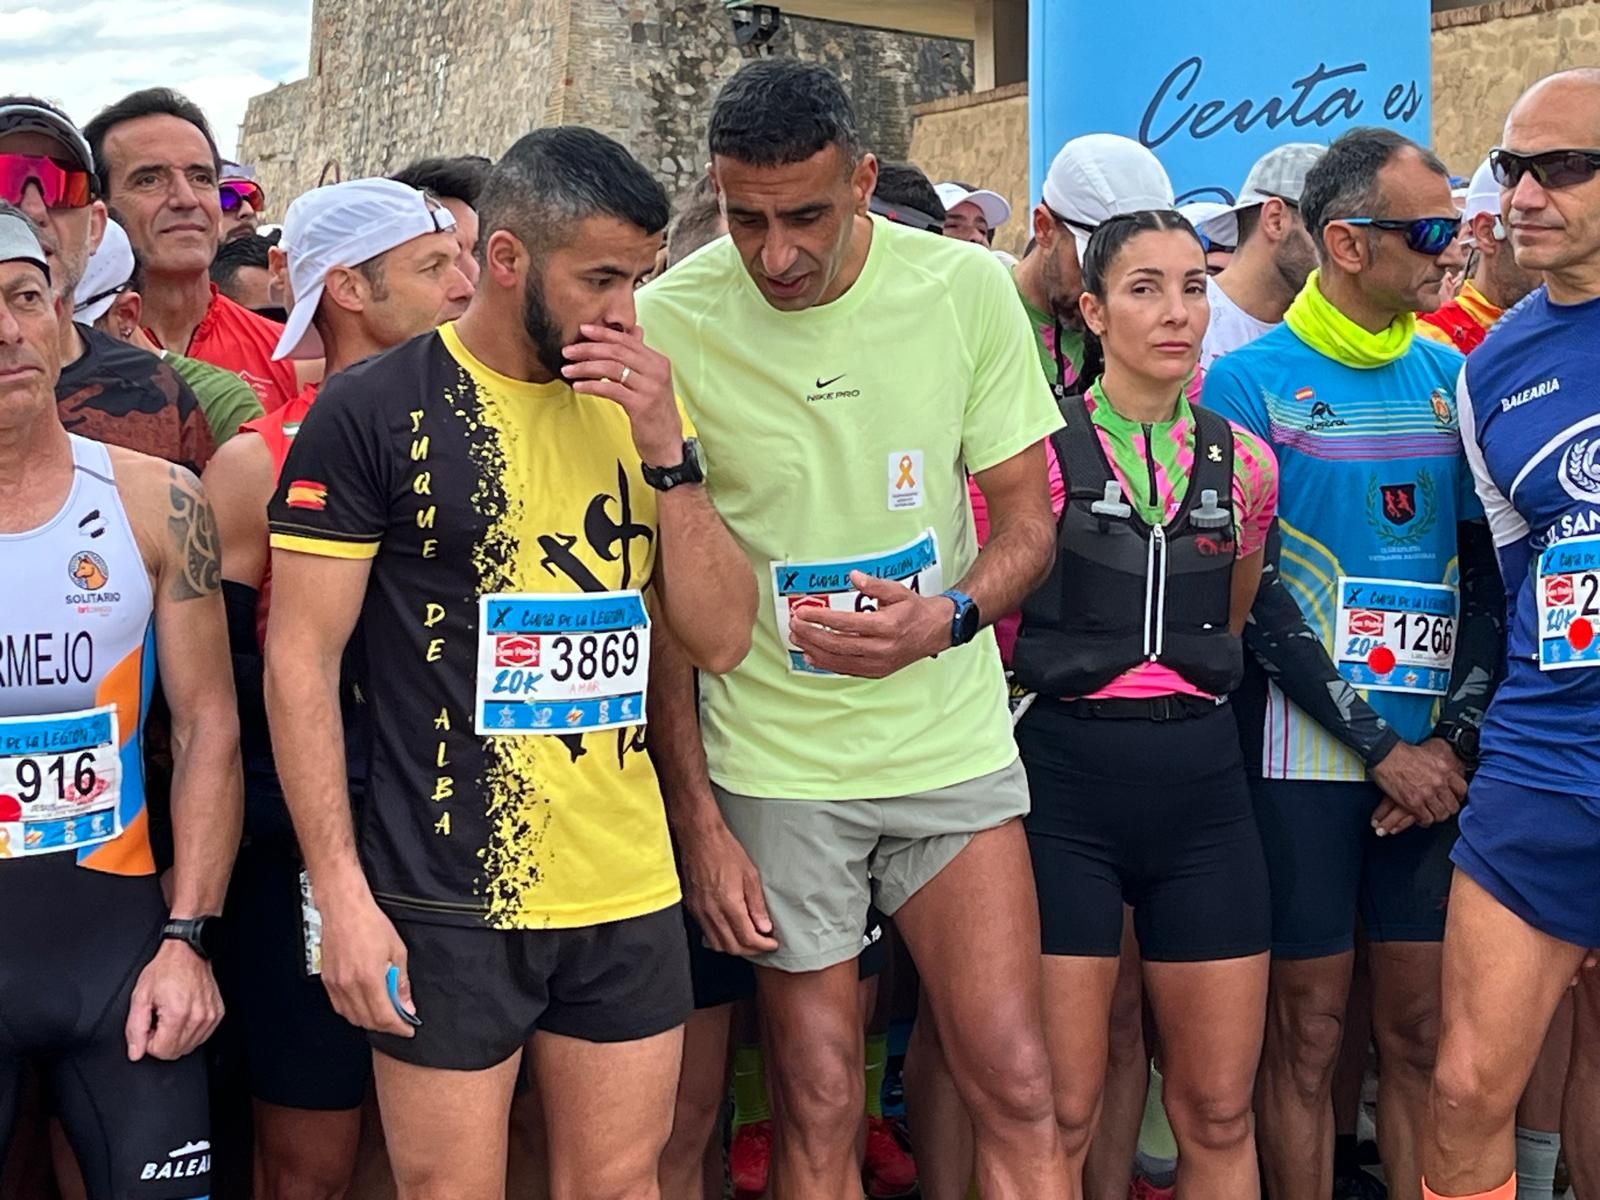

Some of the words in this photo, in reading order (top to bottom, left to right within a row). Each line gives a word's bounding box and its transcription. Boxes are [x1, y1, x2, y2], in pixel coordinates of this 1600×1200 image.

[1384, 79, 1423, 122] es
[806, 392, 833, 402] NIKE
[835, 389, 860, 399] PRO
[1501, 378, 1560, 412] BALEARIA
[782, 571, 800, 591] X
[65, 592, 121, 605] SOLITARIO
[1347, 588, 1363, 605] X
[493, 606, 512, 628] X
[1393, 614, 1453, 654] 1266
[550, 631, 639, 682] 3869
[492, 669, 544, 694] 20K
[16, 752, 96, 803] 916
[431, 707, 454, 836] ALBA
